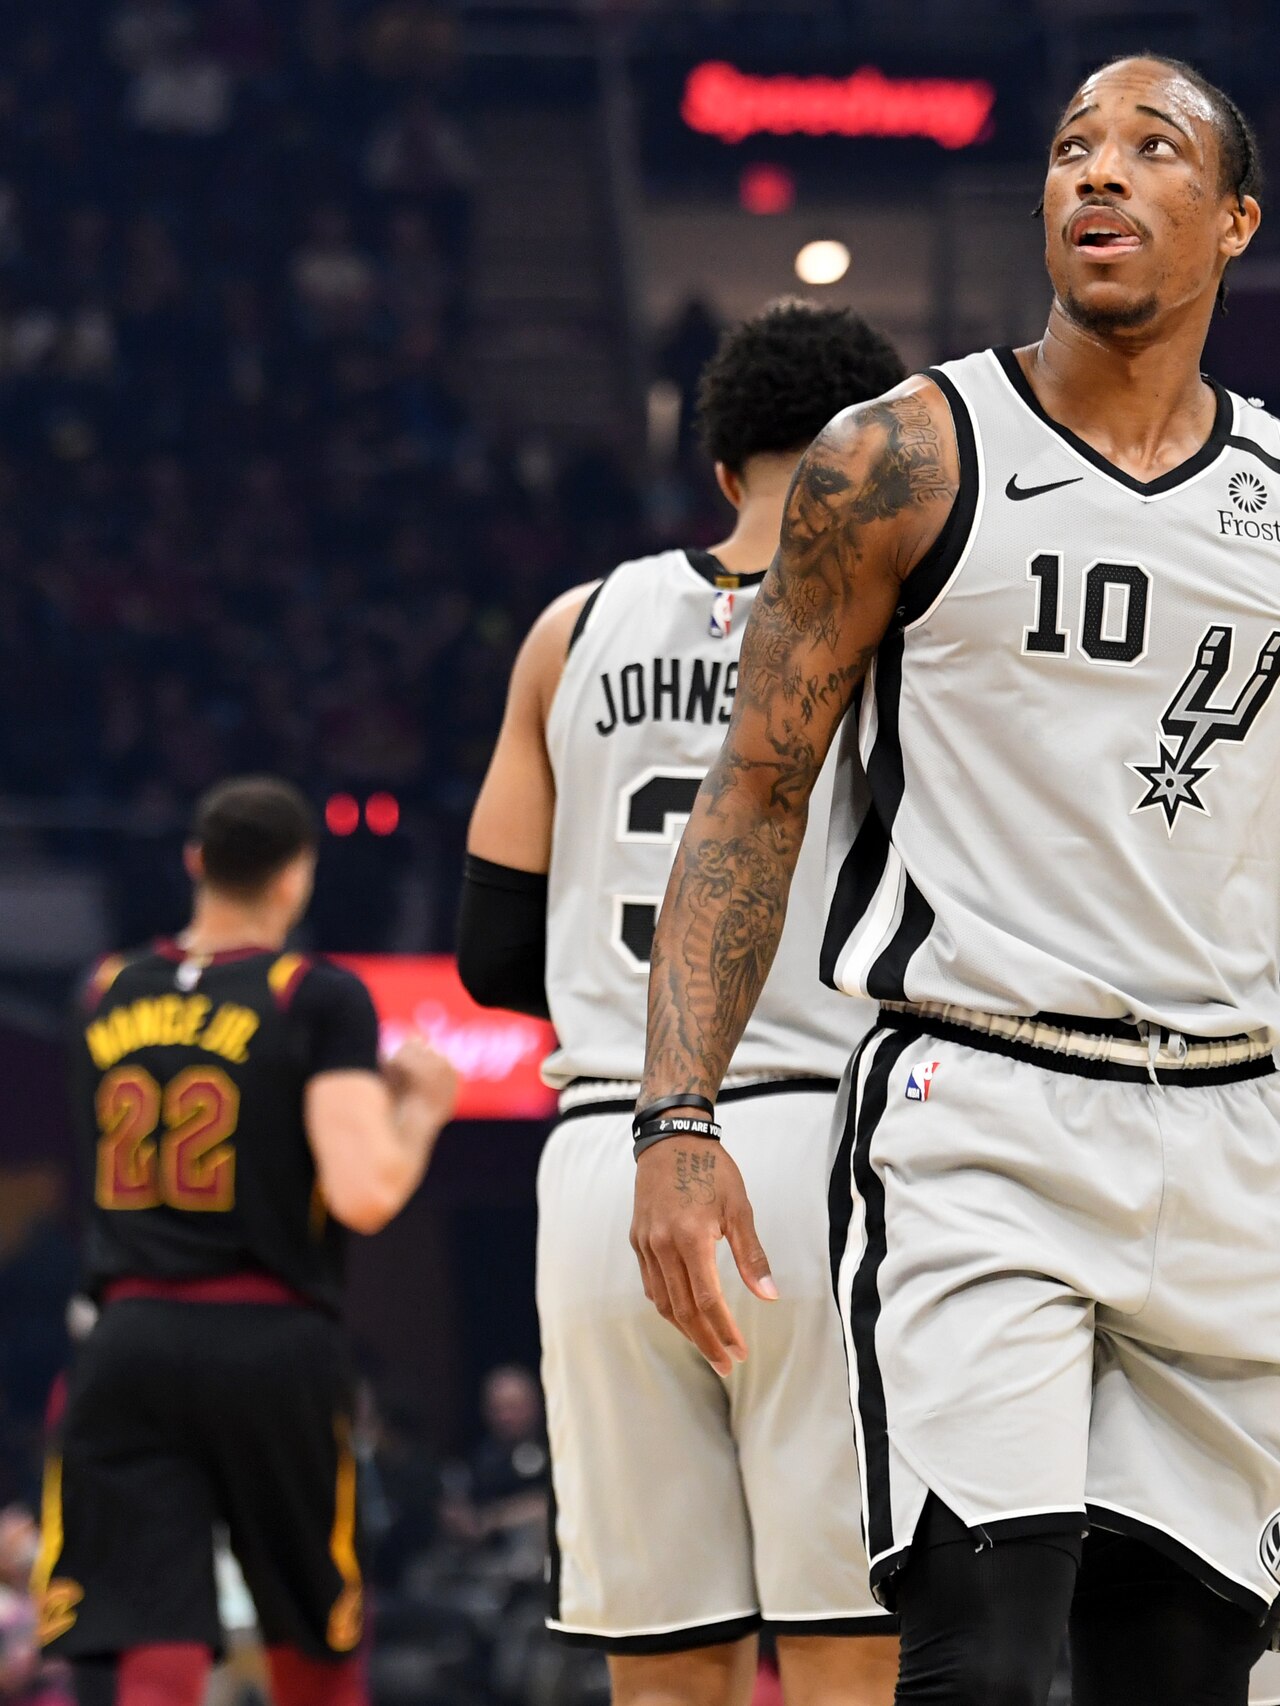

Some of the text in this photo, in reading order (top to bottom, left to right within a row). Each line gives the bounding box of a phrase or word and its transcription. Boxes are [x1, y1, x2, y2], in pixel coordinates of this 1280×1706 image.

[1021, 549, 1153, 667] 10
[95, 1064, 241, 1213] 22
[672, 1119, 690, 1130] YOU
[691, 1121, 708, 1134] ARE
